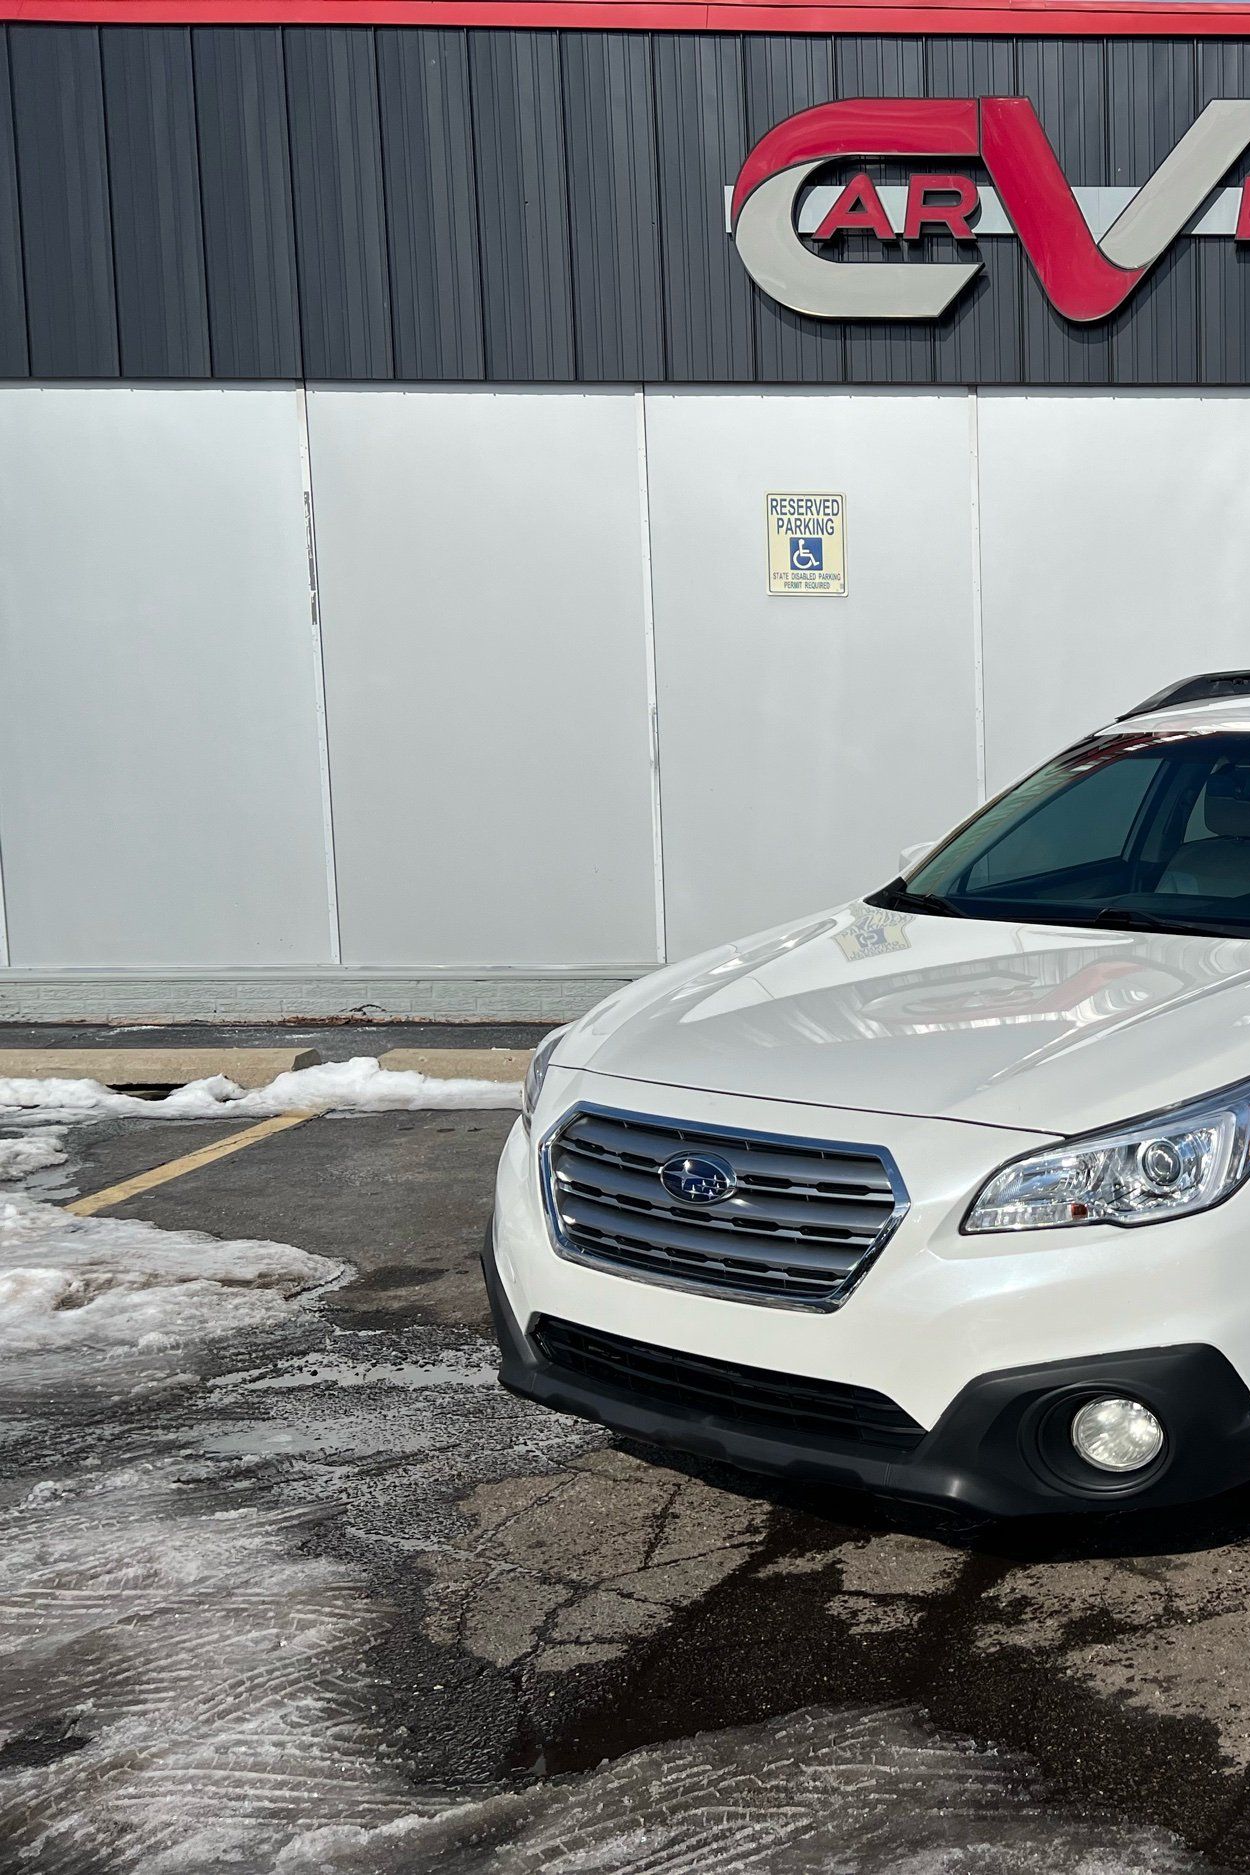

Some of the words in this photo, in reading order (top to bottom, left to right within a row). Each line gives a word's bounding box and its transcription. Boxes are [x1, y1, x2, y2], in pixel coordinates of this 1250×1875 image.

[770, 498, 840, 516] RESERVED
[776, 517, 835, 536] PARKING
[773, 572, 790, 580] STATE
[791, 572, 817, 580] DISABLED
[818, 573, 841, 581] PARKING
[784, 581, 803, 589] PERMIT
[804, 582, 831, 590] REQUIRED
